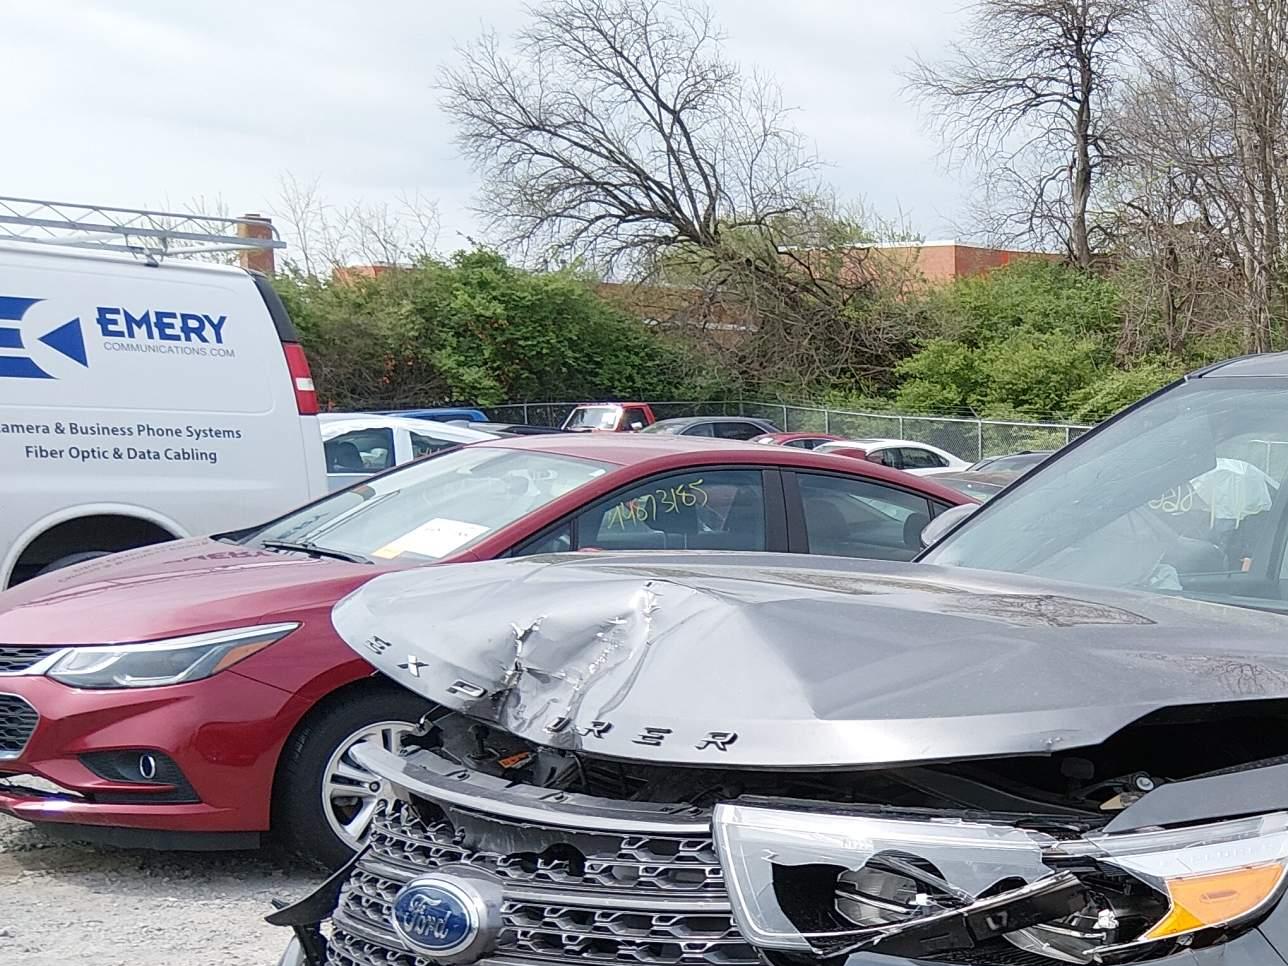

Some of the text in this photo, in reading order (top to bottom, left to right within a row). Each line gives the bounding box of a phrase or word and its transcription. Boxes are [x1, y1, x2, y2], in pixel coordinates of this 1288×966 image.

[96, 306, 227, 344] EMERY
[0, 422, 242, 440] amera & Business Phone Systems
[25, 445, 217, 464] Fiber Optic & Data Cabling
[365, 634, 739, 752] EXPORER
[404, 894, 452, 939] Ford
